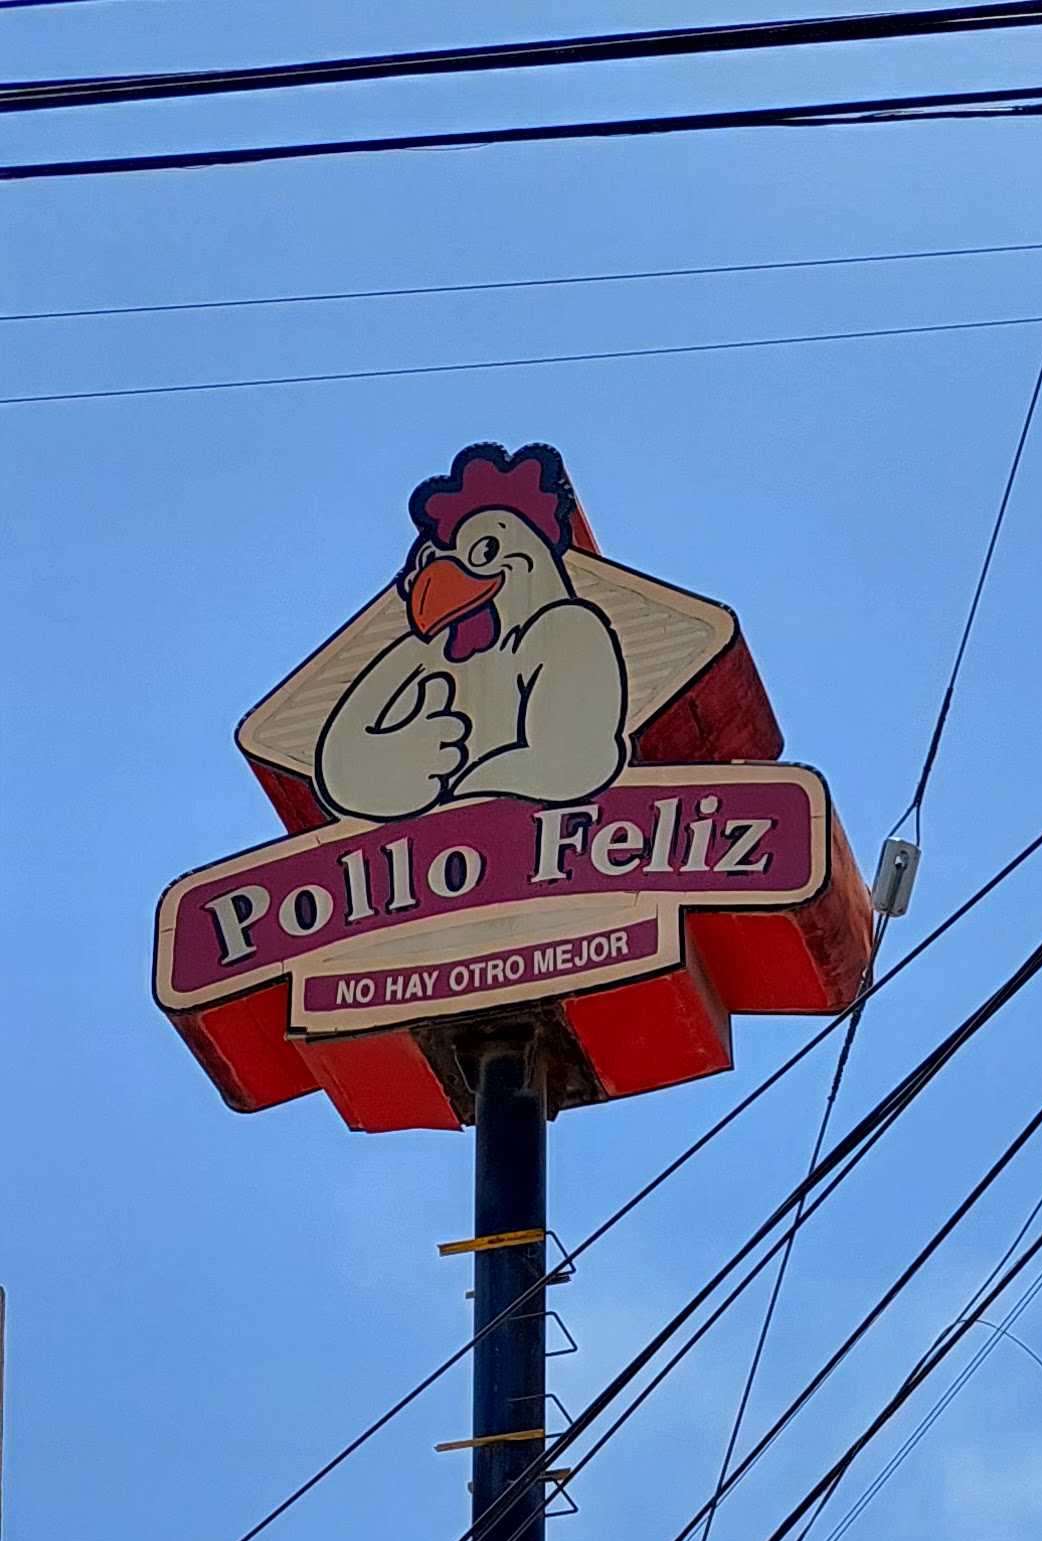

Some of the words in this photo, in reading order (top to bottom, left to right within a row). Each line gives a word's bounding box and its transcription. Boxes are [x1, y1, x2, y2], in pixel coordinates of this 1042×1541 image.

[202, 838, 484, 967] Pollo
[529, 794, 778, 885] Feliz
[335, 979, 375, 1006] NO
[385, 969, 439, 1001] HAY
[449, 955, 525, 990] OTRO
[534, 931, 629, 976] MEJOR
